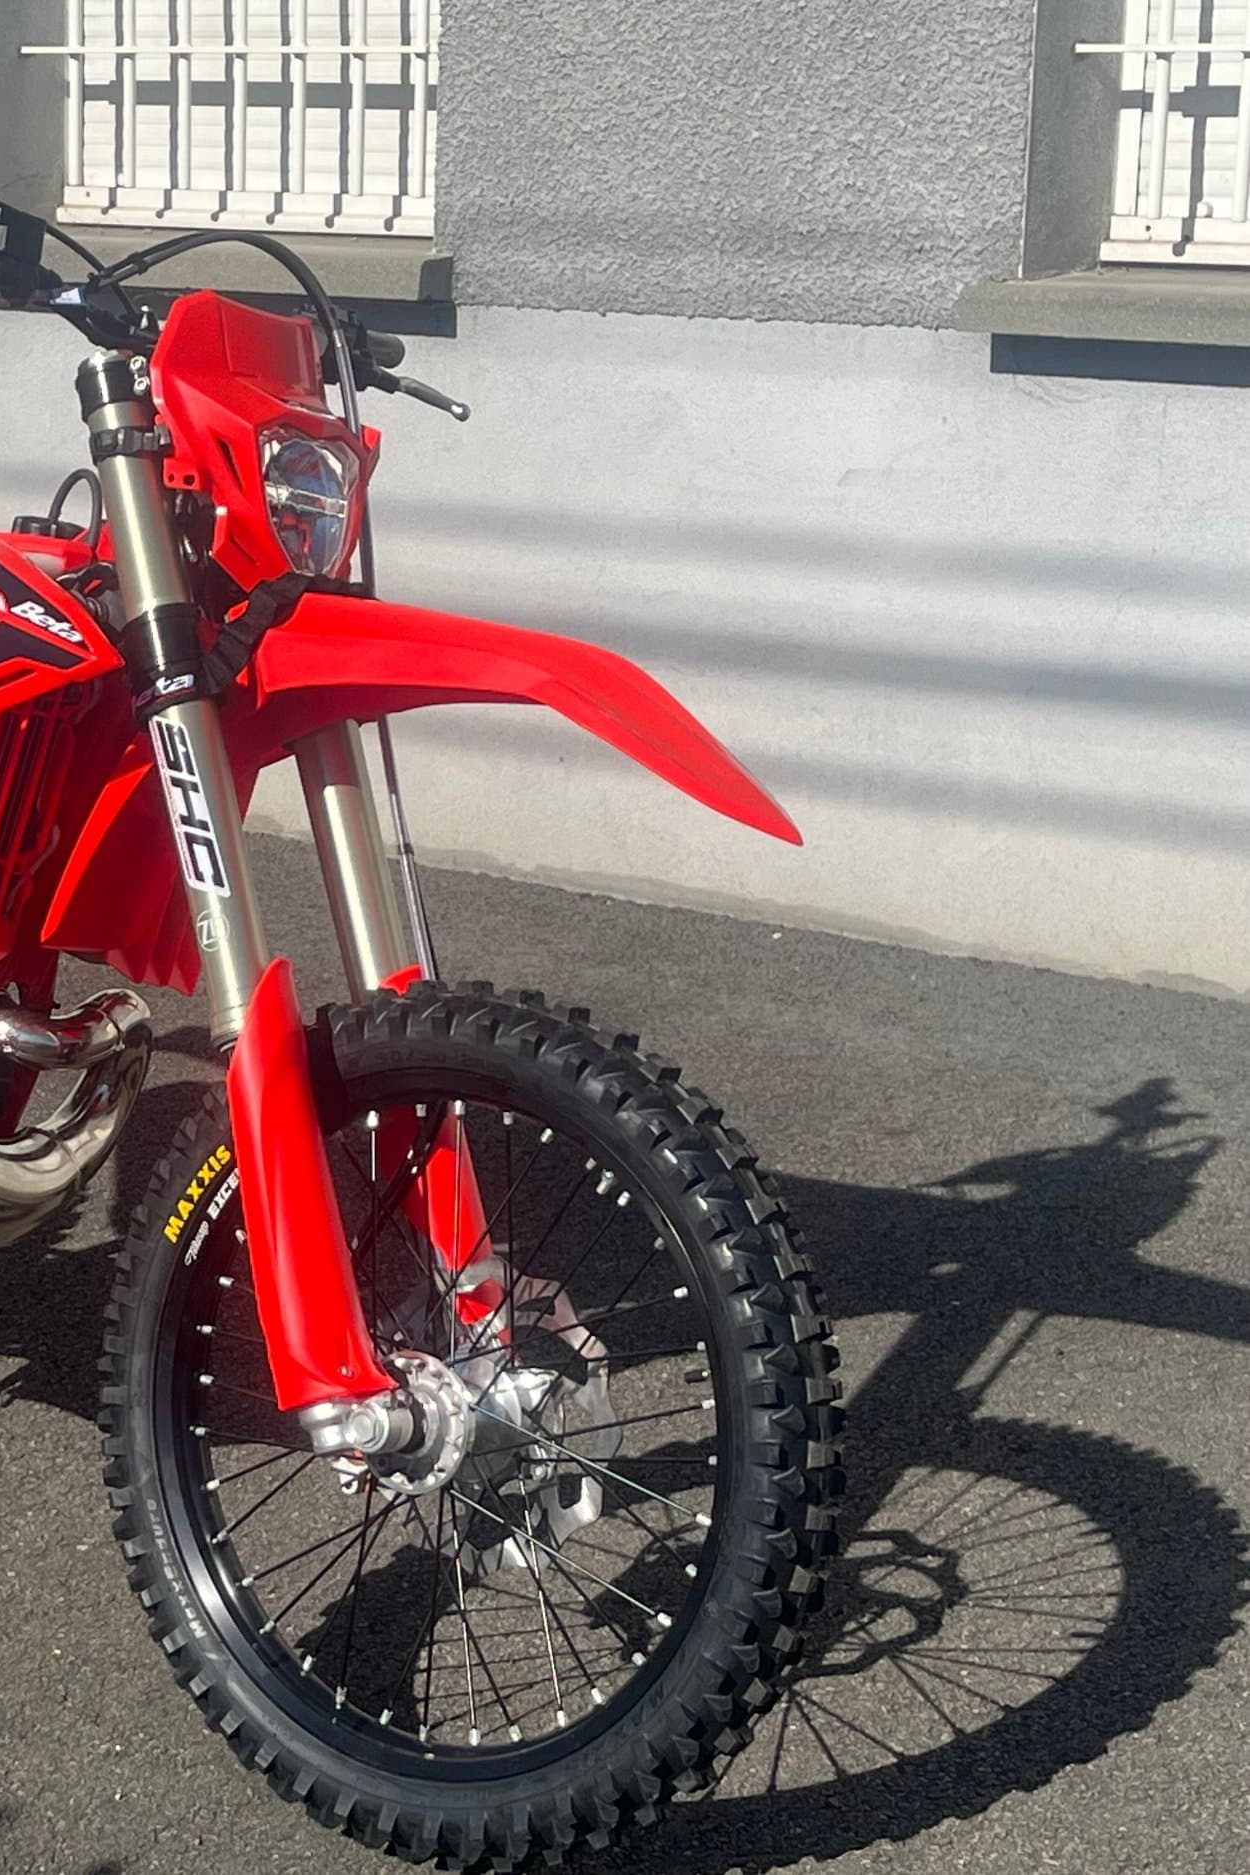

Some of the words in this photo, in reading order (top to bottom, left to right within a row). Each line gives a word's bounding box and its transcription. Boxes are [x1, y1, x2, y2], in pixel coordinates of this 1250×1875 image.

[10, 600, 85, 643] Beta
[155, 719, 226, 888] SHC
[163, 1145, 231, 1243] MAXXIS
